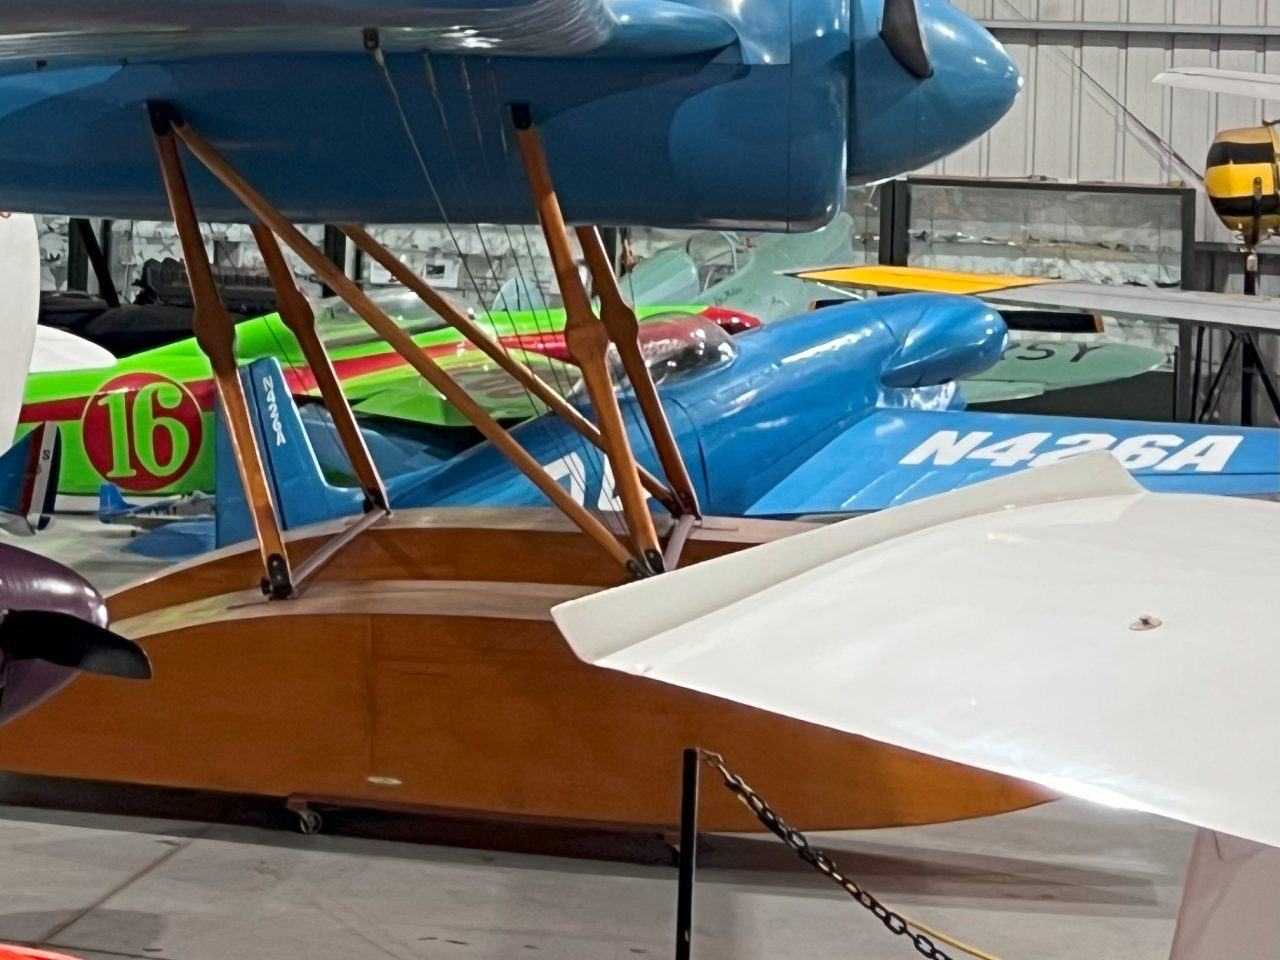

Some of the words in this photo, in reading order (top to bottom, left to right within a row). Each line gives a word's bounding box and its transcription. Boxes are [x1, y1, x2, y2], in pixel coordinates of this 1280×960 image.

[97, 381, 190, 477] 16
[262, 375, 287, 447] N426A
[898, 430, 1244, 473] N426A
